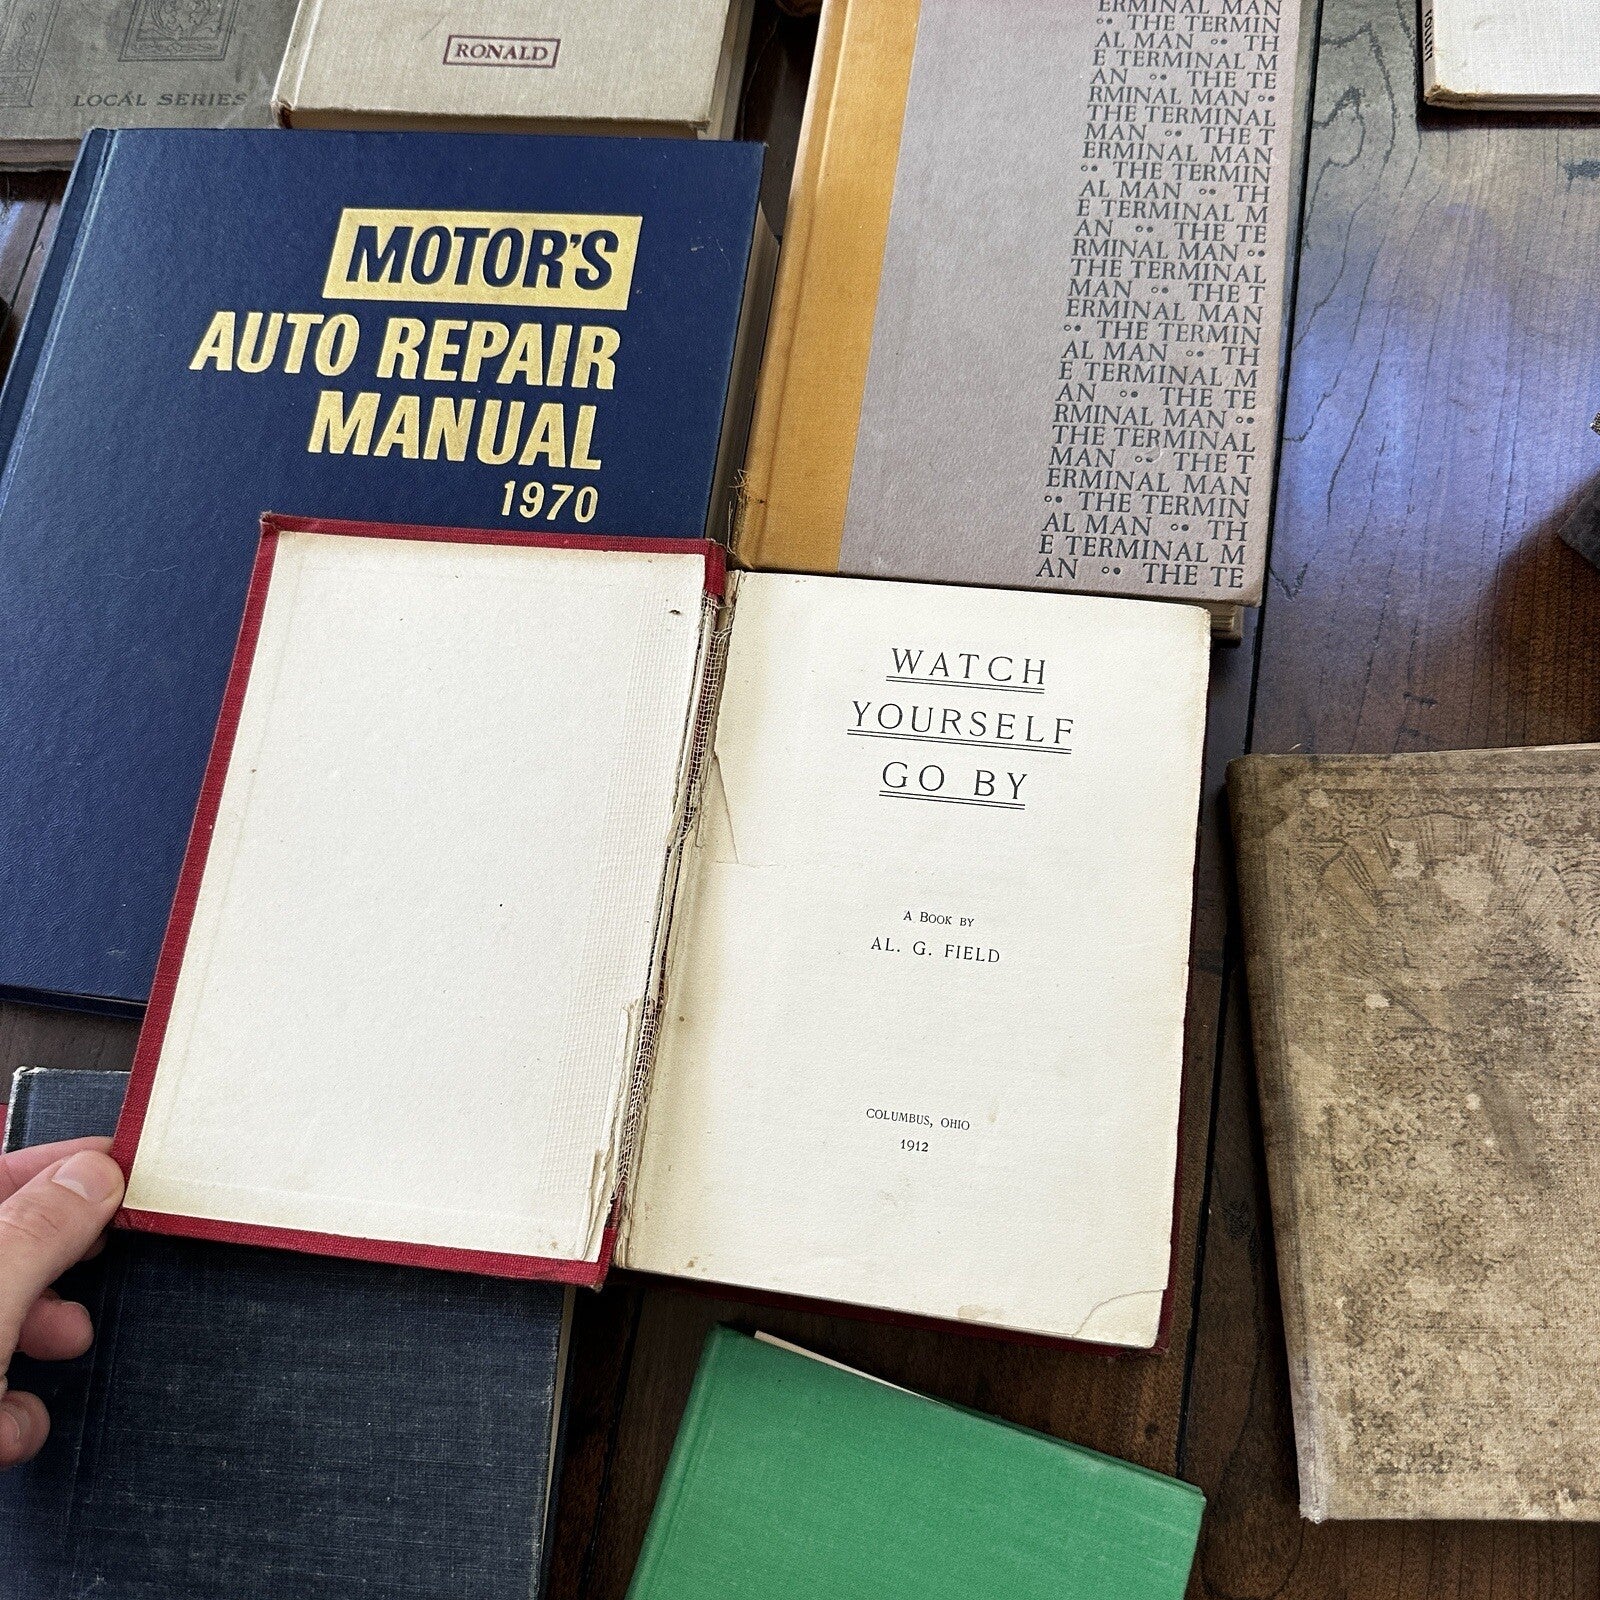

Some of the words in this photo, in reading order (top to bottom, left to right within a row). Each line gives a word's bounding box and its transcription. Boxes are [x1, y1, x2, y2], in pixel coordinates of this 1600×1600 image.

[1098, 0, 1209, 14] ERMINAL
[1221, 0, 1282, 15] MAN
[1127, 14, 1175, 31] THE
[1185, 15, 1281, 33] TERMIN
[454, 43, 548, 60] RONALD
[1095, 31, 1124, 48] AL
[1134, 33, 1194, 49] MAN
[1244, 35, 1279, 52] TH
[1093, 49, 1105, 66] E
[1116, 50, 1245, 69] TERMINAL
[1257, 54, 1278, 71] M
[1090, 68, 1128, 84] AN
[1187, 70, 1236, 87] THE
[1247, 72, 1276, 89] TE
[73, 93, 146, 107] LOCAL
[157, 93, 248, 106] SERIES
[1088, 86, 1181, 104] RMINAL
[1191, 89, 1249, 106] MAN
[1087, 104, 1136, 122] THE
[1145, 106, 1275, 127] TERMINAL
[1085, 122, 1147, 141] MAN
[1200, 126, 1251, 144] THE
[1259, 129, 1275, 145] T
[1083, 141, 1198, 162] ERMINAL
[1210, 146, 1273, 165] MAN
[1113, 161, 1162, 179] THE
[1172, 163, 1271, 184] TERMIN
[1079, 180, 1110, 197] AL
[1120, 181, 1182, 199] MAN
[1233, 185, 1270, 203] TH
[1077, 199, 1090, 216] E
[1102, 200, 1234, 222] TERMINAL
[1246, 206, 1268, 223] M
[1074, 219, 1113, 237] AN
[1174, 222, 1225, 241] THE
[1236, 225, 1266, 243] TE
[346, 225, 621, 290] MOTOR'S
[1072, 238, 1169, 259] RMINAL
[1178, 242, 1239, 262] MAN
[1071, 258, 1122, 277] THE
[1131, 260, 1266, 284] TERMINAL
[1068, 278, 1132, 298] MAN
[1188, 283, 1240, 303] THE
[1249, 286, 1265, 304] T
[1066, 299, 1185, 321] ERMINAL
[1198, 304, 1263, 324] MAN
[1097, 320, 1148, 340] THE
[1158, 323, 1261, 346] TERMIN
[189, 312, 360, 376] AUTO
[376, 318, 621, 389] REPAIR
[1061, 340, 1093, 359] AL
[1103, 342, 1168, 362] MAN
[1222, 346, 1260, 366] TH
[1058, 361, 1073, 380] E
[1085, 362, 1222, 386] TERMINAL
[1234, 369, 1258, 388] M
[1055, 382, 1096, 402] AN
[1159, 387, 1212, 407] THE
[1224, 389, 1256, 409] TE
[1053, 404, 1153, 426] RMINAL
[1163, 408, 1227, 429] MAN
[308, 391, 601, 469] MANUAL
[1052, 425, 1105, 445] THE
[1114, 427, 1255, 452] TERMINAL
[1049, 446, 1116, 468] MAN
[1173, 452, 1227, 473] THE
[1237, 455, 1254, 474] T
[1046, 468, 1170, 492] ERMINAL
[1183, 474, 1252, 496] MAN
[500, 481, 598, 523] 1970
[1079, 491, 1131, 512] THE
[1142, 494, 1249, 519] TERMIN
[1041, 512, 1074, 532] AL
[1085, 514, 1152, 536] MAN
[1208, 520, 1248, 541] TH
[1039, 534, 1053, 554] E
[1066, 536, 1208, 562] TERMINAL
[1220, 544, 1245, 565] M
[1036, 557, 1078, 579] AN
[1143, 563, 1198, 585] THE
[1211, 566, 1243, 588] TE
[892, 648, 1045, 684] WATCH
[852, 701, 1073, 744] YOURSELF
[883, 762, 944, 791] GO
[974, 769, 1027, 799] BY
[903, 911, 912, 921] A
[960, 918, 974, 927] BY
[871, 937, 900, 952] AL.
[912, 940, 932, 957] G.
[945, 944, 999, 962] FIELD
[866, 1108, 933, 1128] COLUMBUS,
[941, 1118, 970, 1130] OHIO
[901, 1139, 928, 1152] 1912
